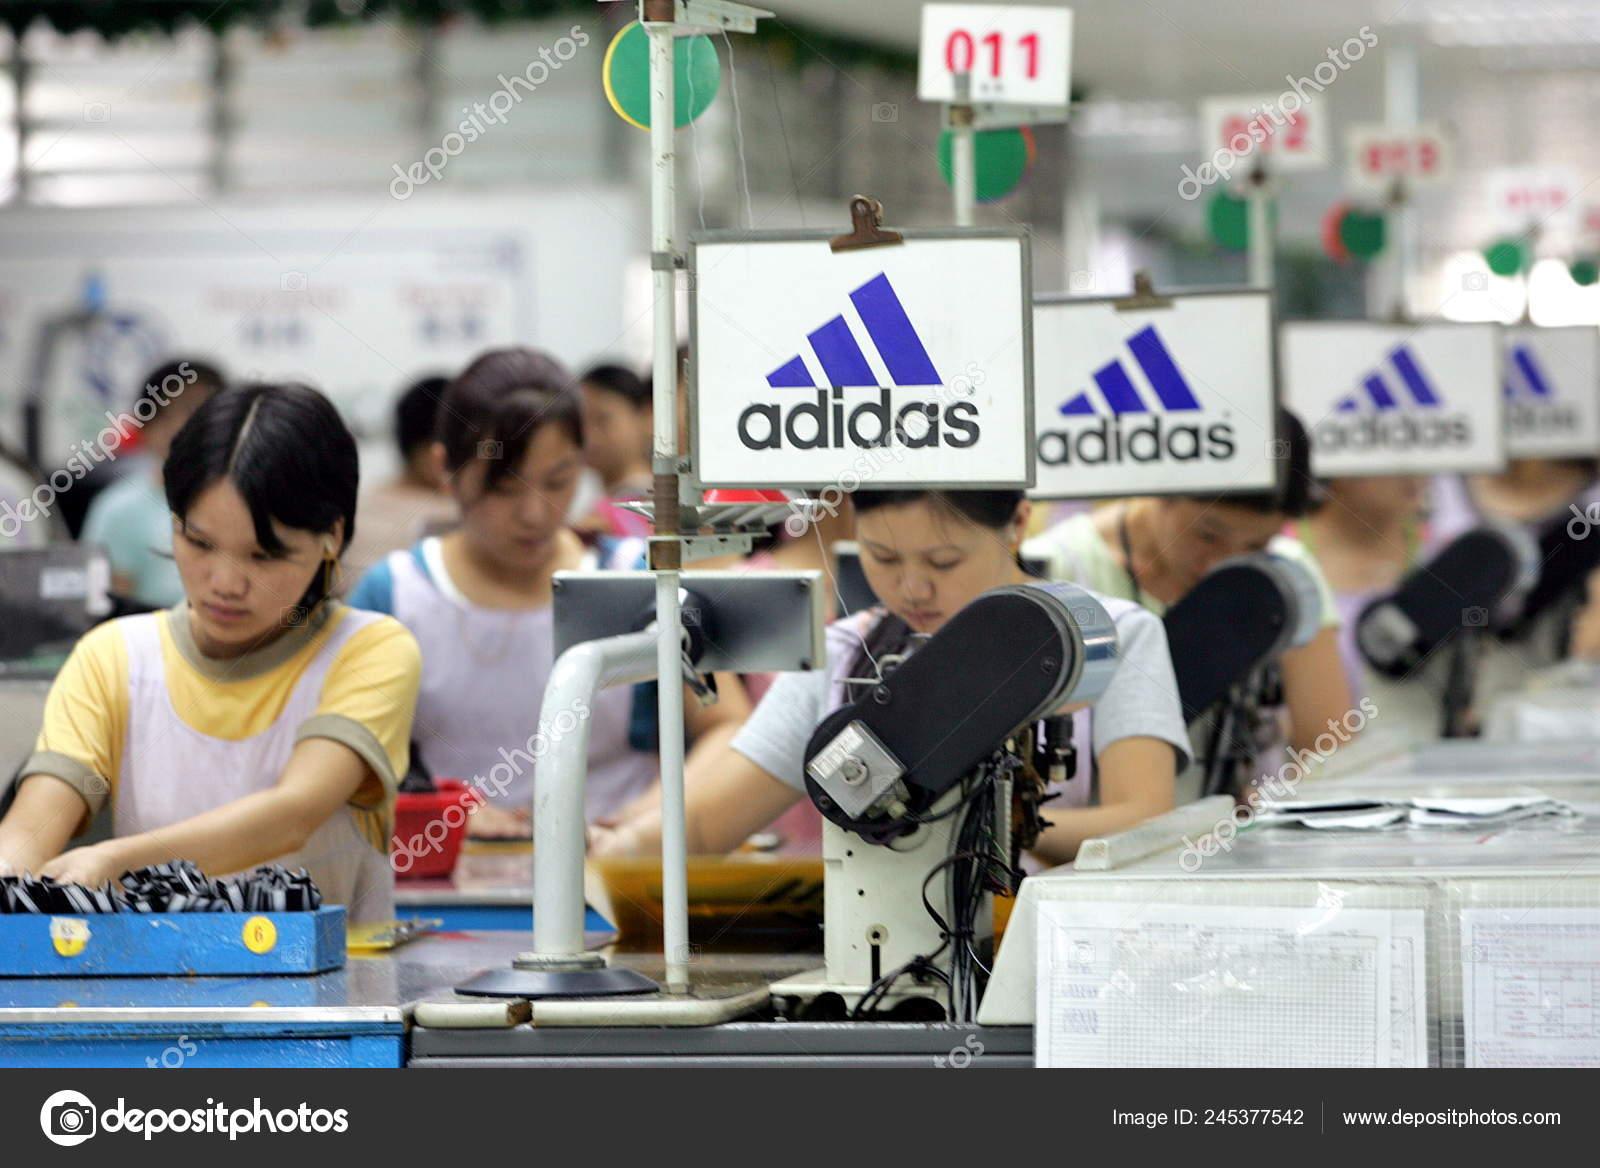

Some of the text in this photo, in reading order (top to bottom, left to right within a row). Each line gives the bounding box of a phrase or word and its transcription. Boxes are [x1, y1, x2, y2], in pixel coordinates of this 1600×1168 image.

[945, 30, 1038, 79] 011
[738, 387, 981, 451] adidas
[1037, 414, 1236, 466] adidas
